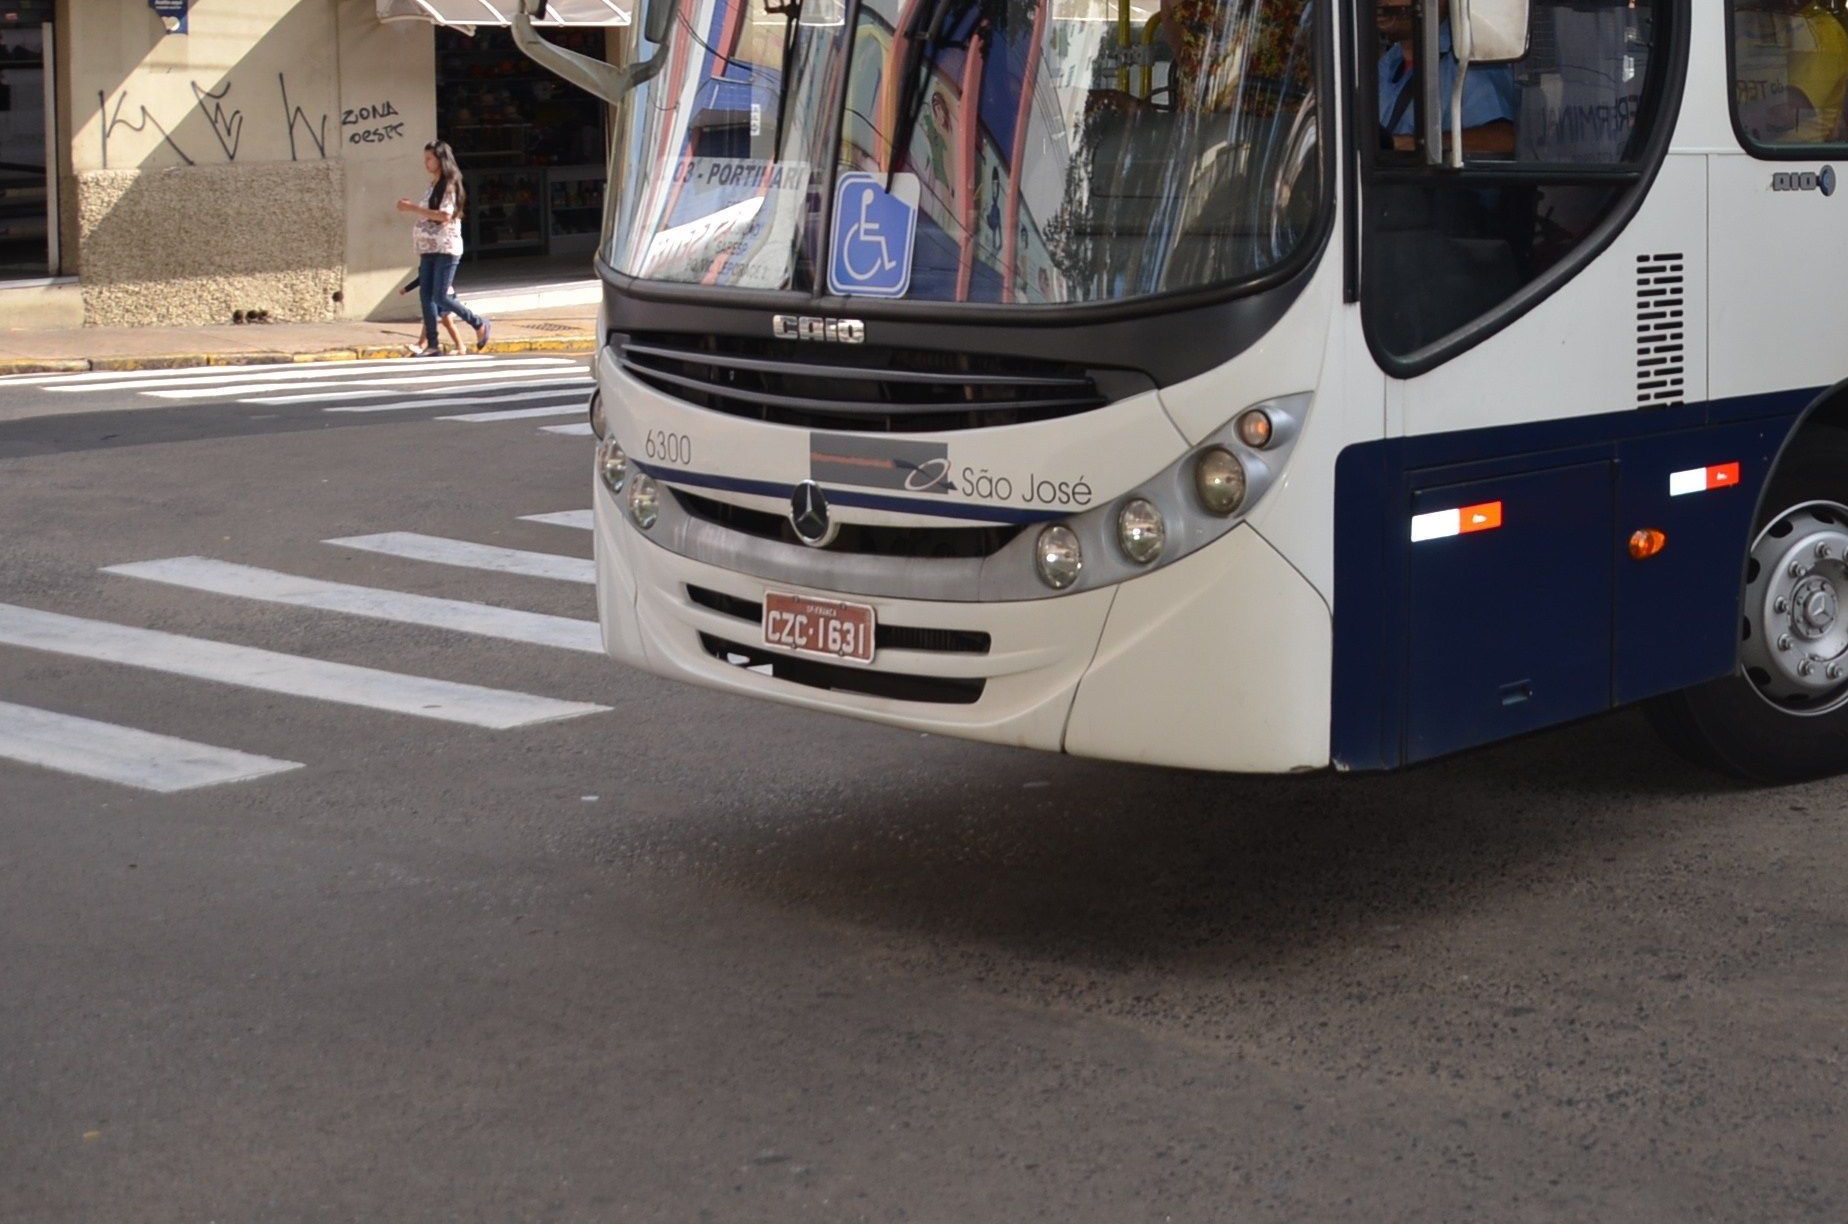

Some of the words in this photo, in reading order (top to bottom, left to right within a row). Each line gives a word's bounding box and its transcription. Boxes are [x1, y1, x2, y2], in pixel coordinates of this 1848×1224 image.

[342, 100, 399, 126] ZONA
[773, 314, 865, 344] CAIO
[644, 428, 692, 465] 6300
[961, 467, 1012, 500] São
[1021, 474, 1092, 505] José
